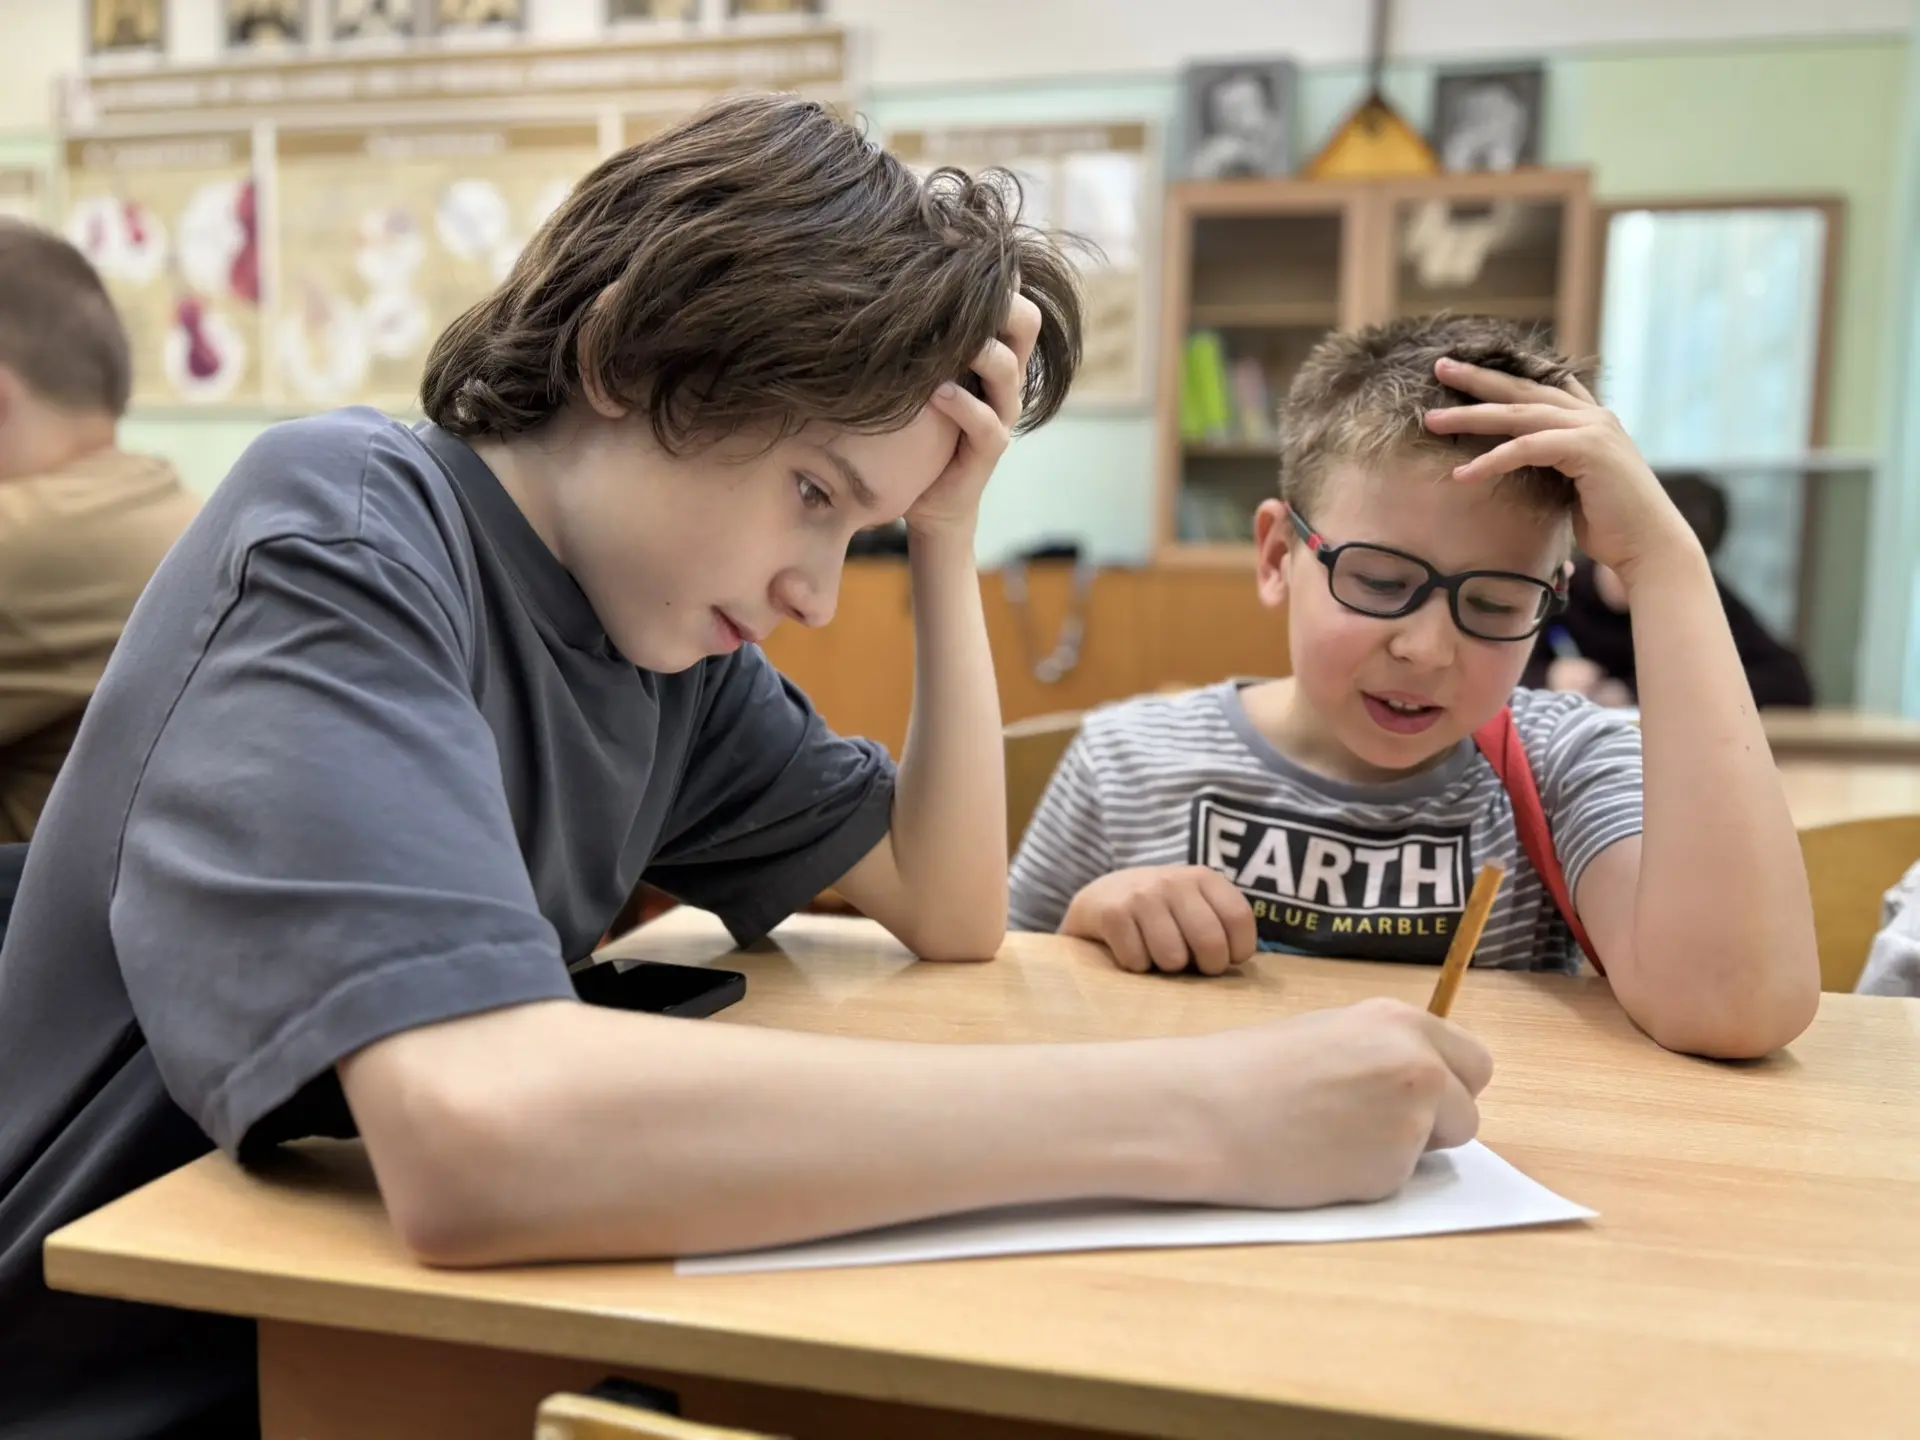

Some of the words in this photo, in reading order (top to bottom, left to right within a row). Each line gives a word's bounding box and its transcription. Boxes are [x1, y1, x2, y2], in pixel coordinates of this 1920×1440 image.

[1207, 811, 1454, 908] EARTH
[1254, 900, 1319, 931] BLUE
[1331, 916, 1448, 935] MARBLE
